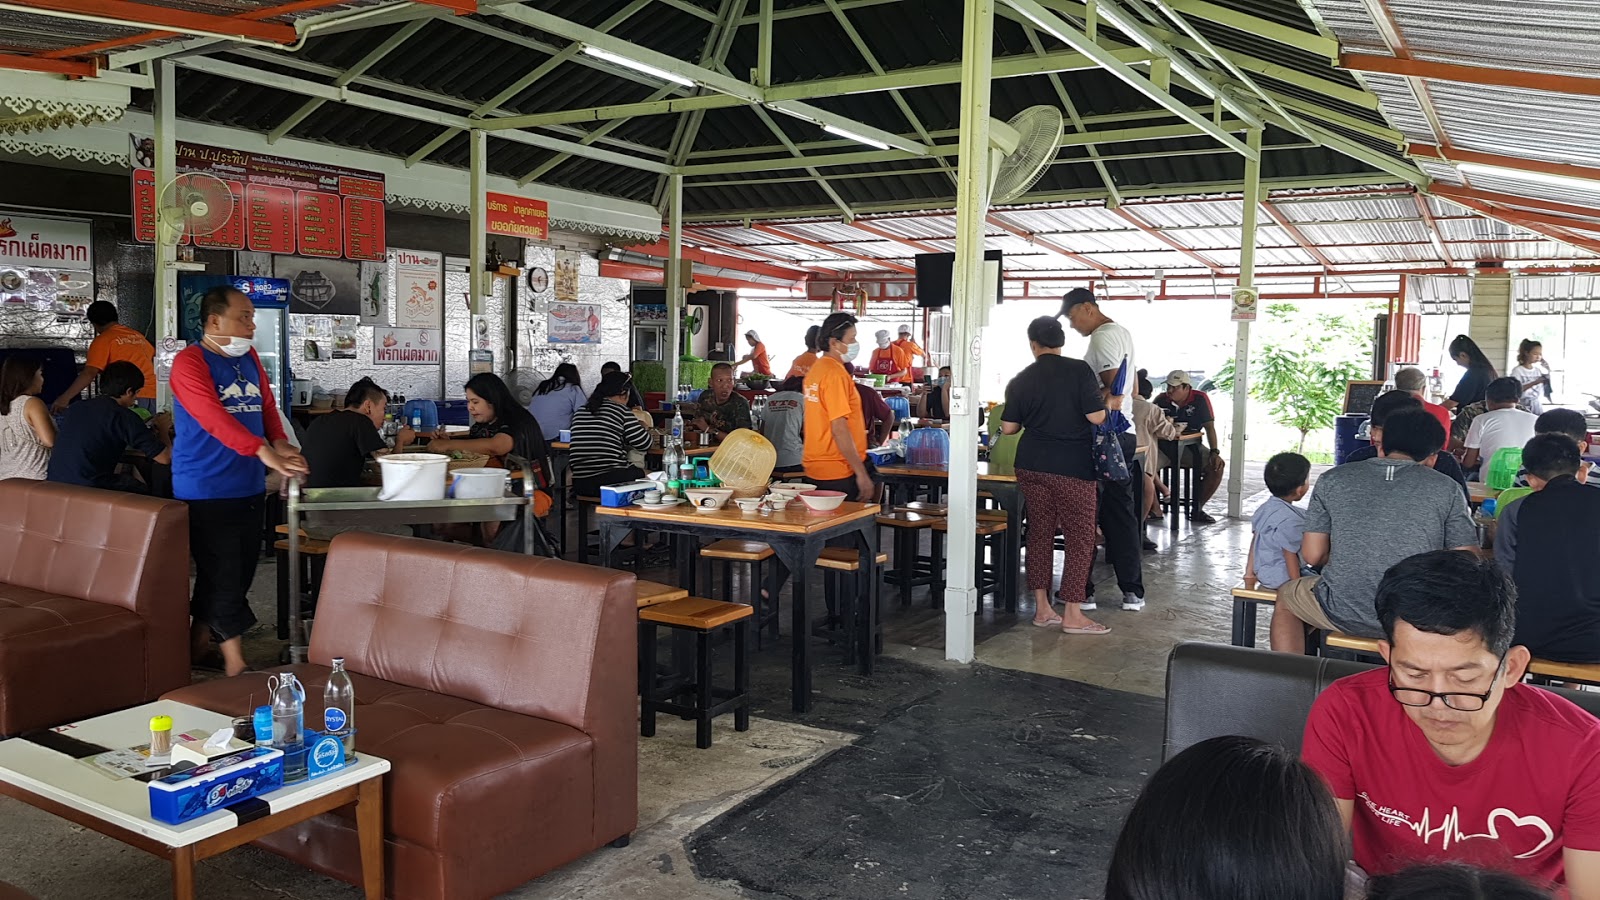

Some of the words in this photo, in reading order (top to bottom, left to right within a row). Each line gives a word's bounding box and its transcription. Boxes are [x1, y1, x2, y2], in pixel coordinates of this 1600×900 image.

[487, 200, 508, 212] บริการ
[1379, 806, 1410, 820] HEART
[1381, 816, 1401, 827] LIFE
